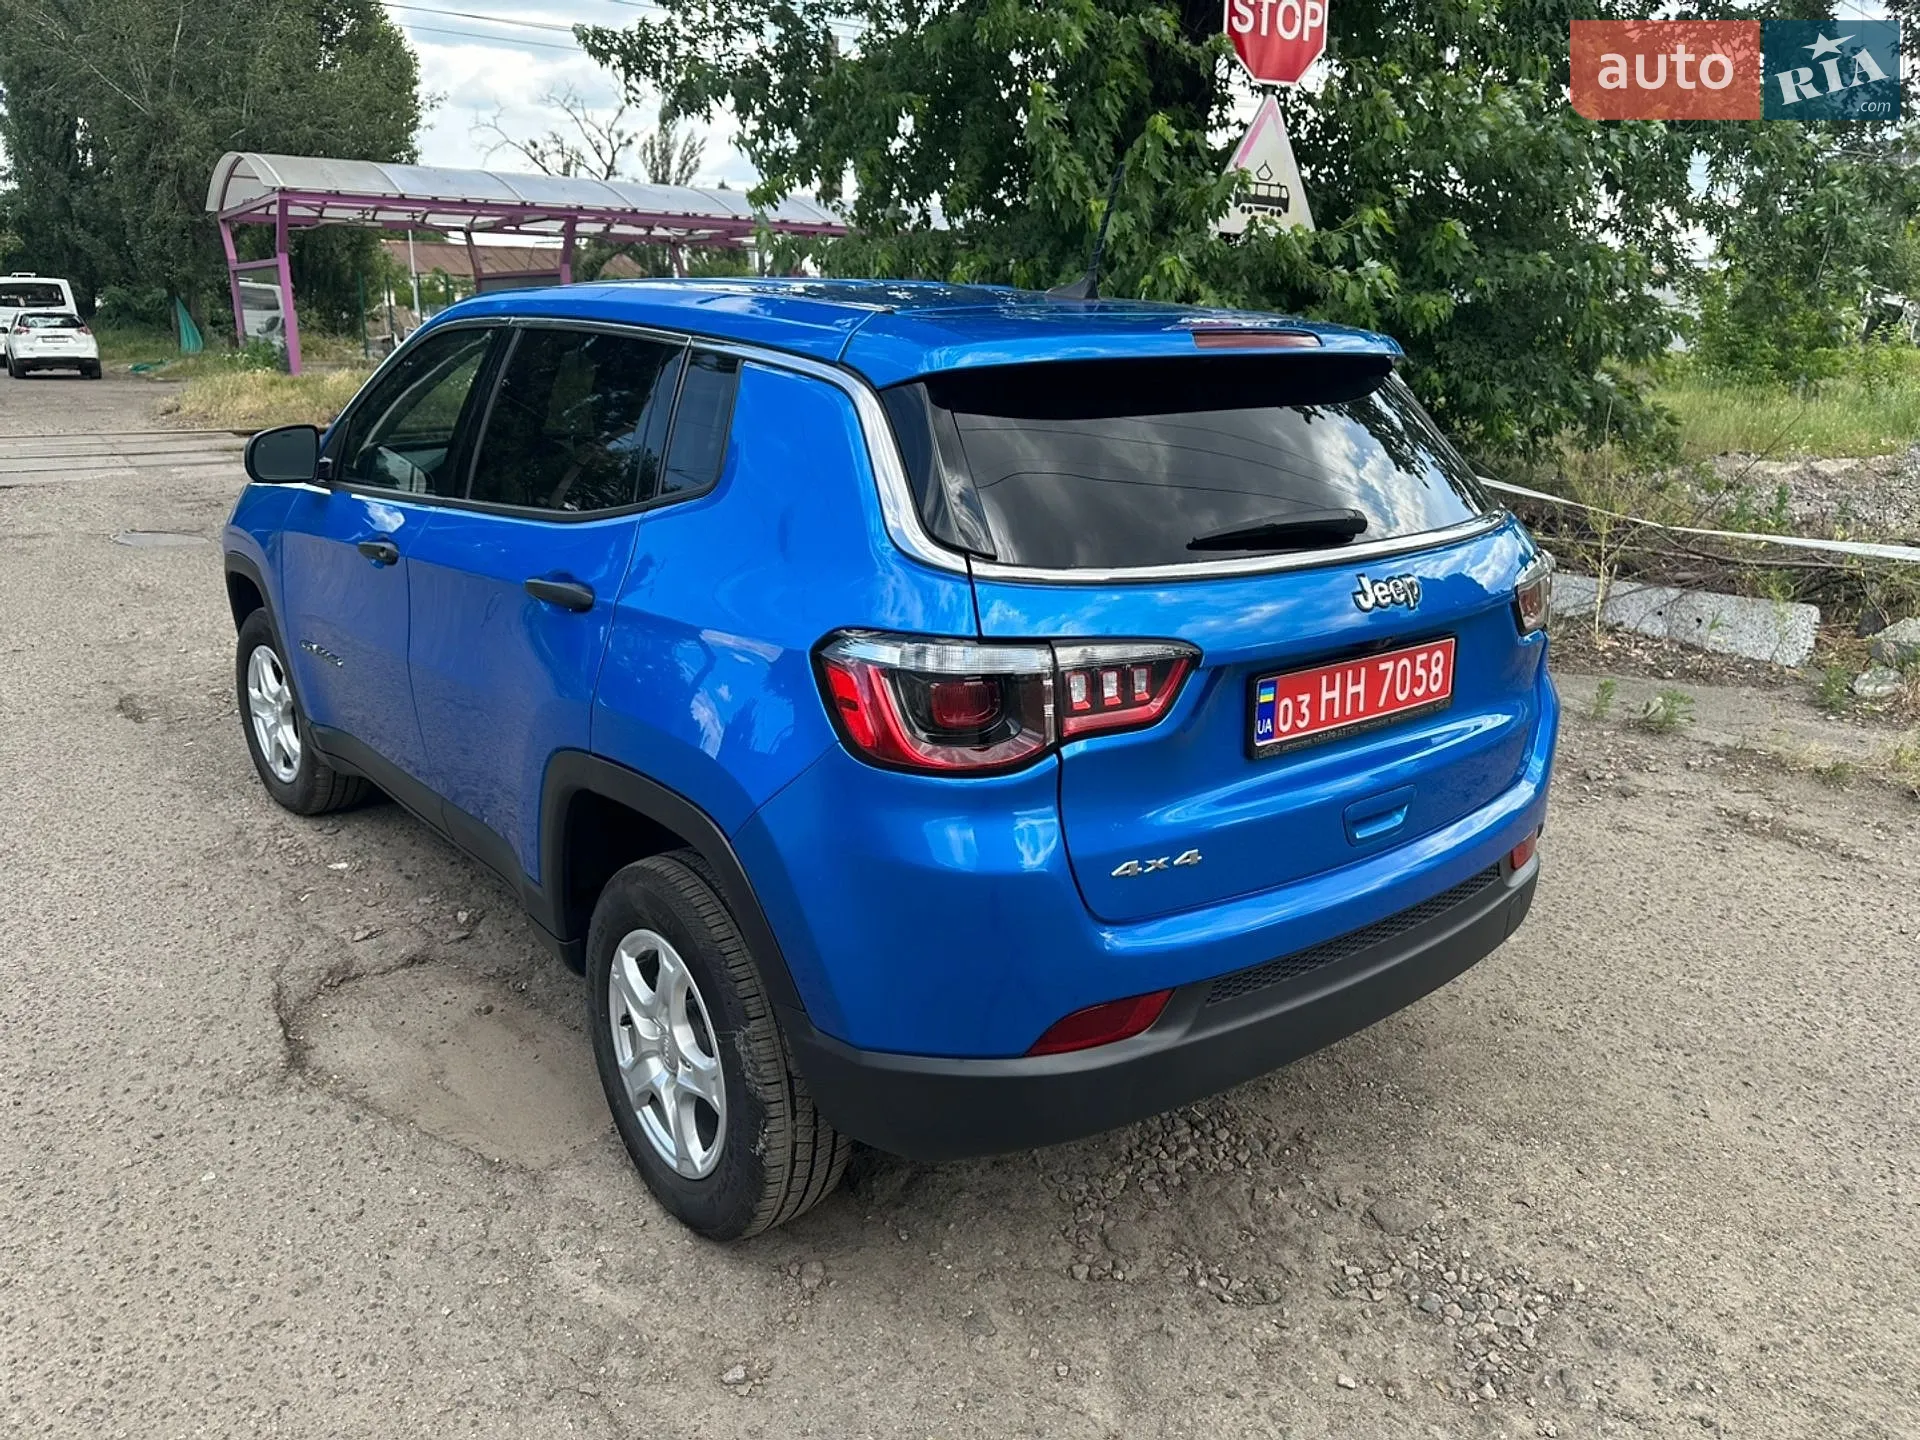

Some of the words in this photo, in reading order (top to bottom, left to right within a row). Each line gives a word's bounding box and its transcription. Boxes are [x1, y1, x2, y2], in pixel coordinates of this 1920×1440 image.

[1231, 0, 1324, 41] STOP
[1352, 573, 1422, 612] Jeep
[1278, 693, 1311, 733] 03
[1320, 667, 1366, 722] HH
[1378, 650, 1445, 708] 7058
[1257, 718, 1273, 735] UA
